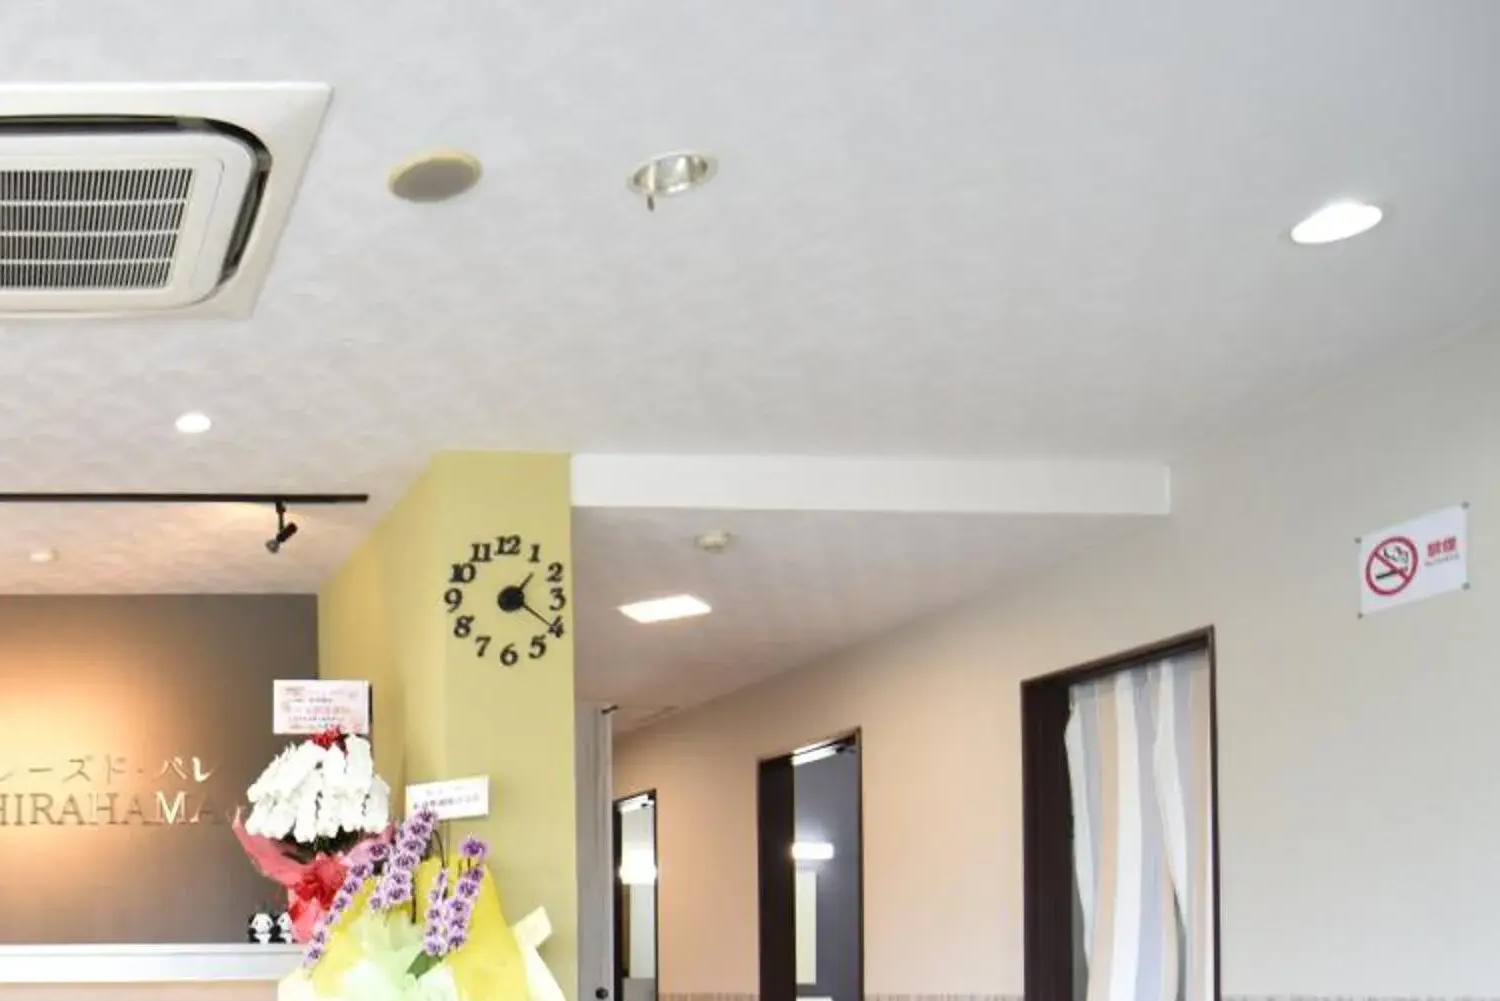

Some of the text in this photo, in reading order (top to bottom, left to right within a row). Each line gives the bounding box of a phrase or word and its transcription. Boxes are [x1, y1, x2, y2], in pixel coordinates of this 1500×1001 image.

[469, 543, 492, 562] 11
[495, 535, 521, 555] 12
[528, 544, 540, 563] 1
[449, 562, 476, 583] 10
[547, 562, 563, 582] 2
[444, 588, 463, 613] 9
[549, 587, 566, 611] 3
[453, 615, 475, 638] 8
[548, 615, 564, 638] 4
[475, 635, 491, 658] 7
[500, 642, 518, 666] 6
[529, 634, 546, 659] 5
